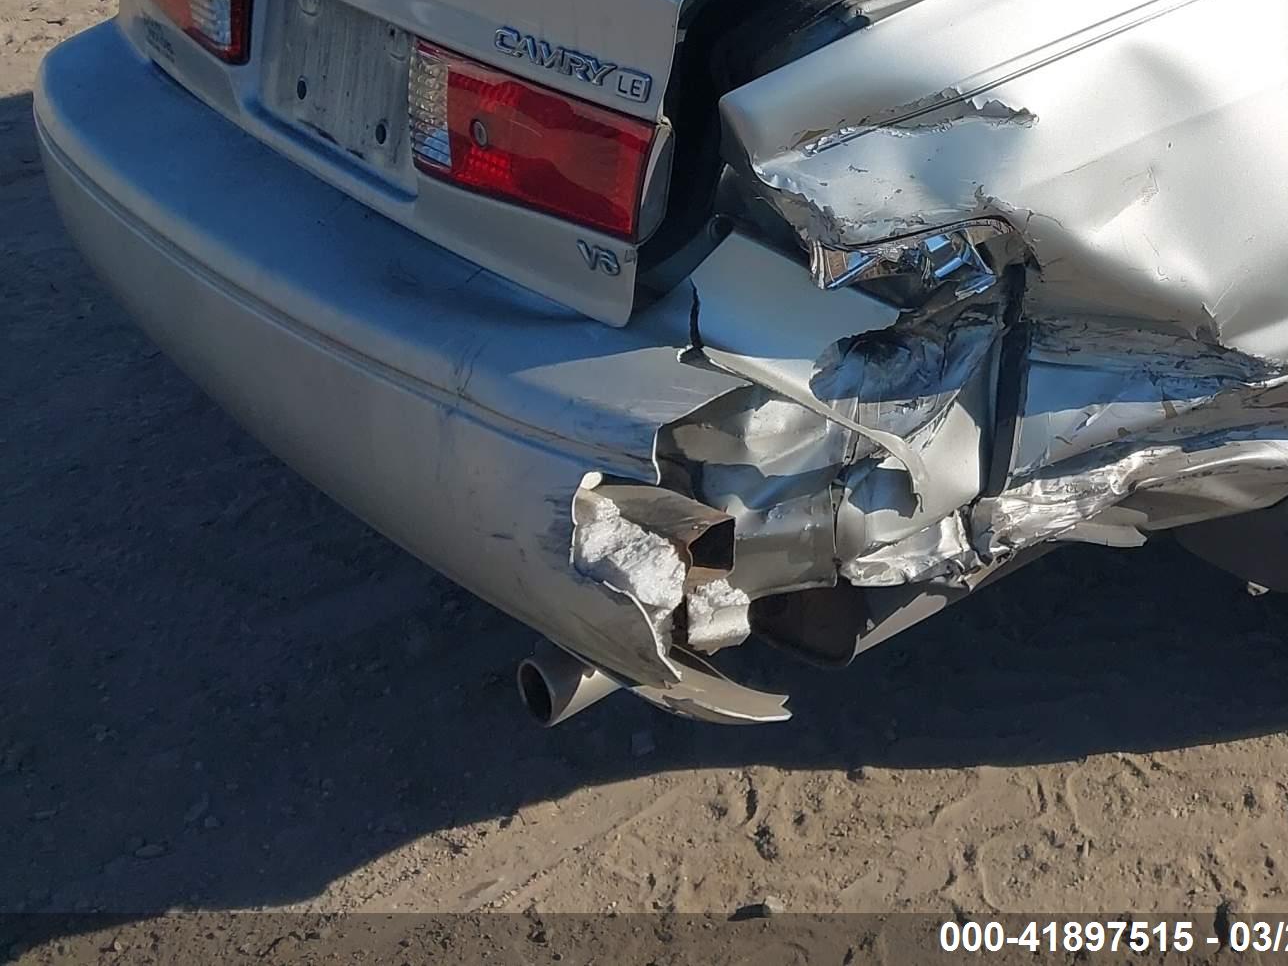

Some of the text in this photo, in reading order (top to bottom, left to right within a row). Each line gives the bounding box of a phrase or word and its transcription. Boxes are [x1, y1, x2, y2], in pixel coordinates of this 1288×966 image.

[494, 25, 645, 99] CAMRY LE
[576, 238, 621, 276] V6
